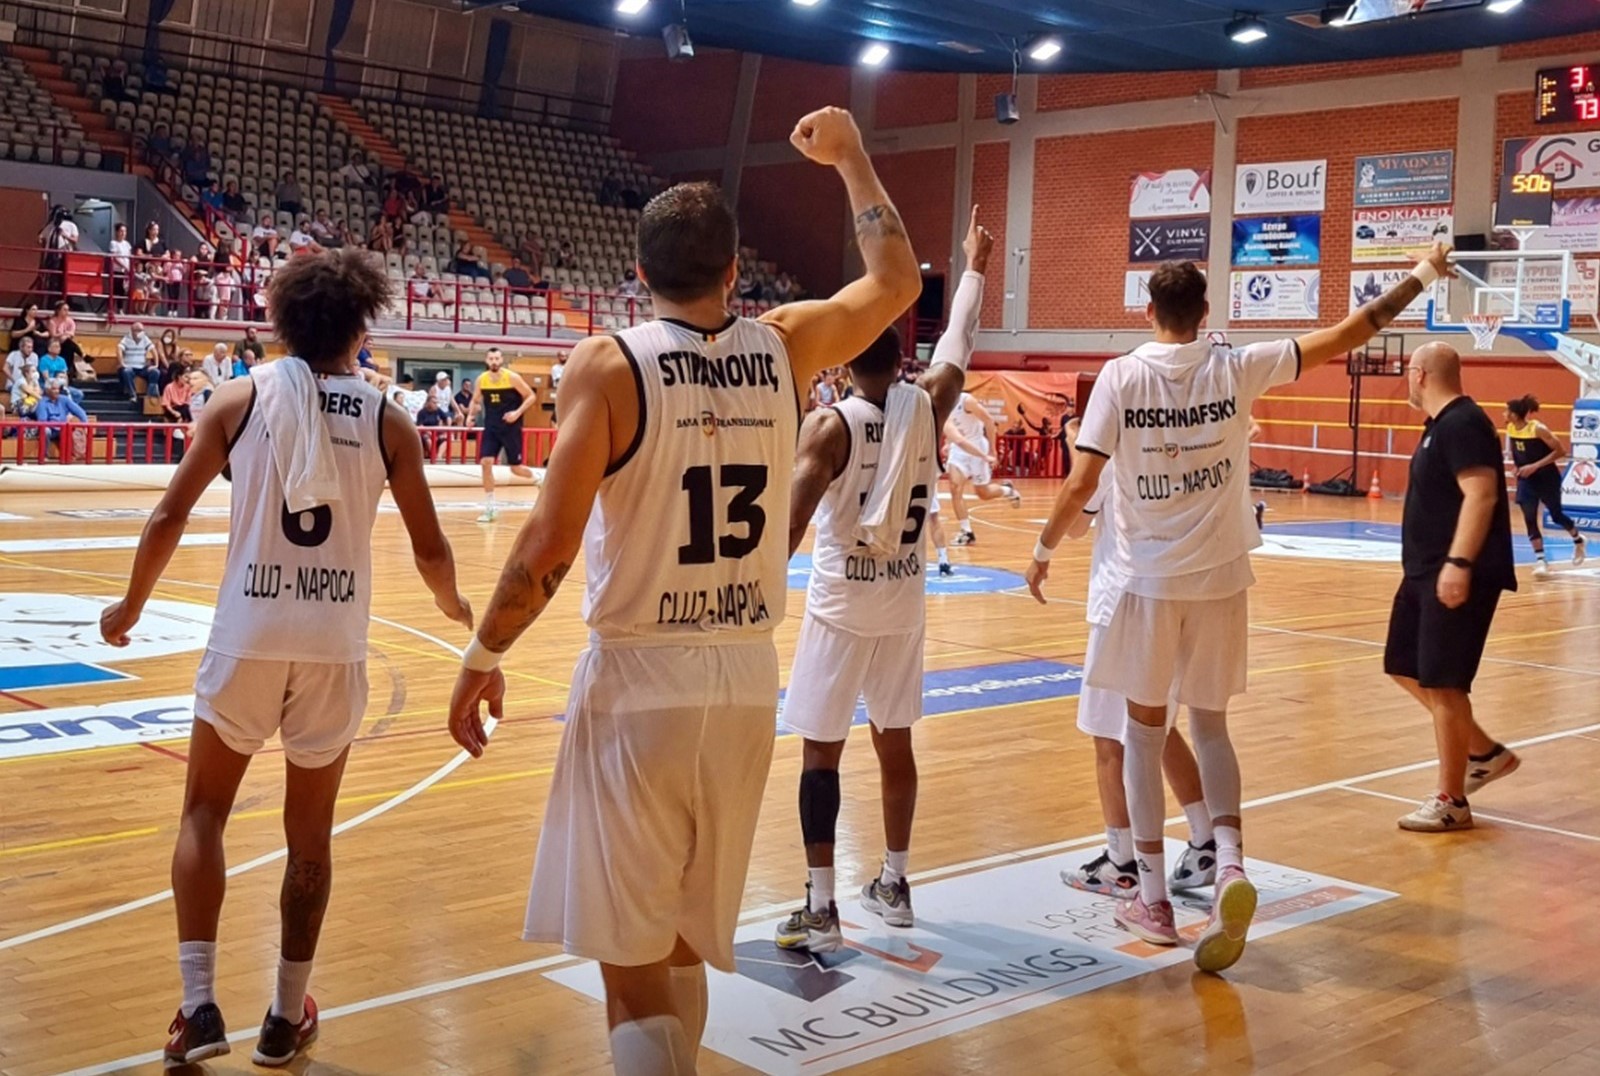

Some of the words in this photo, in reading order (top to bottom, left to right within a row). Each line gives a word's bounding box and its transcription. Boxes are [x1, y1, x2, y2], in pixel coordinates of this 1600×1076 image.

[1574, 98, 1599, 120] 73
[1266, 165, 1322, 190] Bouf
[1356, 207, 1450, 223] ΕΝΟΙΚΙΑΣΕΙΣ
[1165, 227, 1207, 239] VINYL
[1123, 396, 1238, 430] ROSCHNAFSKY
[1136, 473, 1171, 500] CLUJ
[677, 463, 769, 565] 13
[243, 563, 281, 599] CLUJ
[295, 566, 356, 603] NAPOCA
[845, 554, 876, 583] CLUJ
[656, 590, 708, 625] CLUJ
[749, 1016, 860, 1058] MC
[841, 947, 1103, 1029] BUILDINGS
